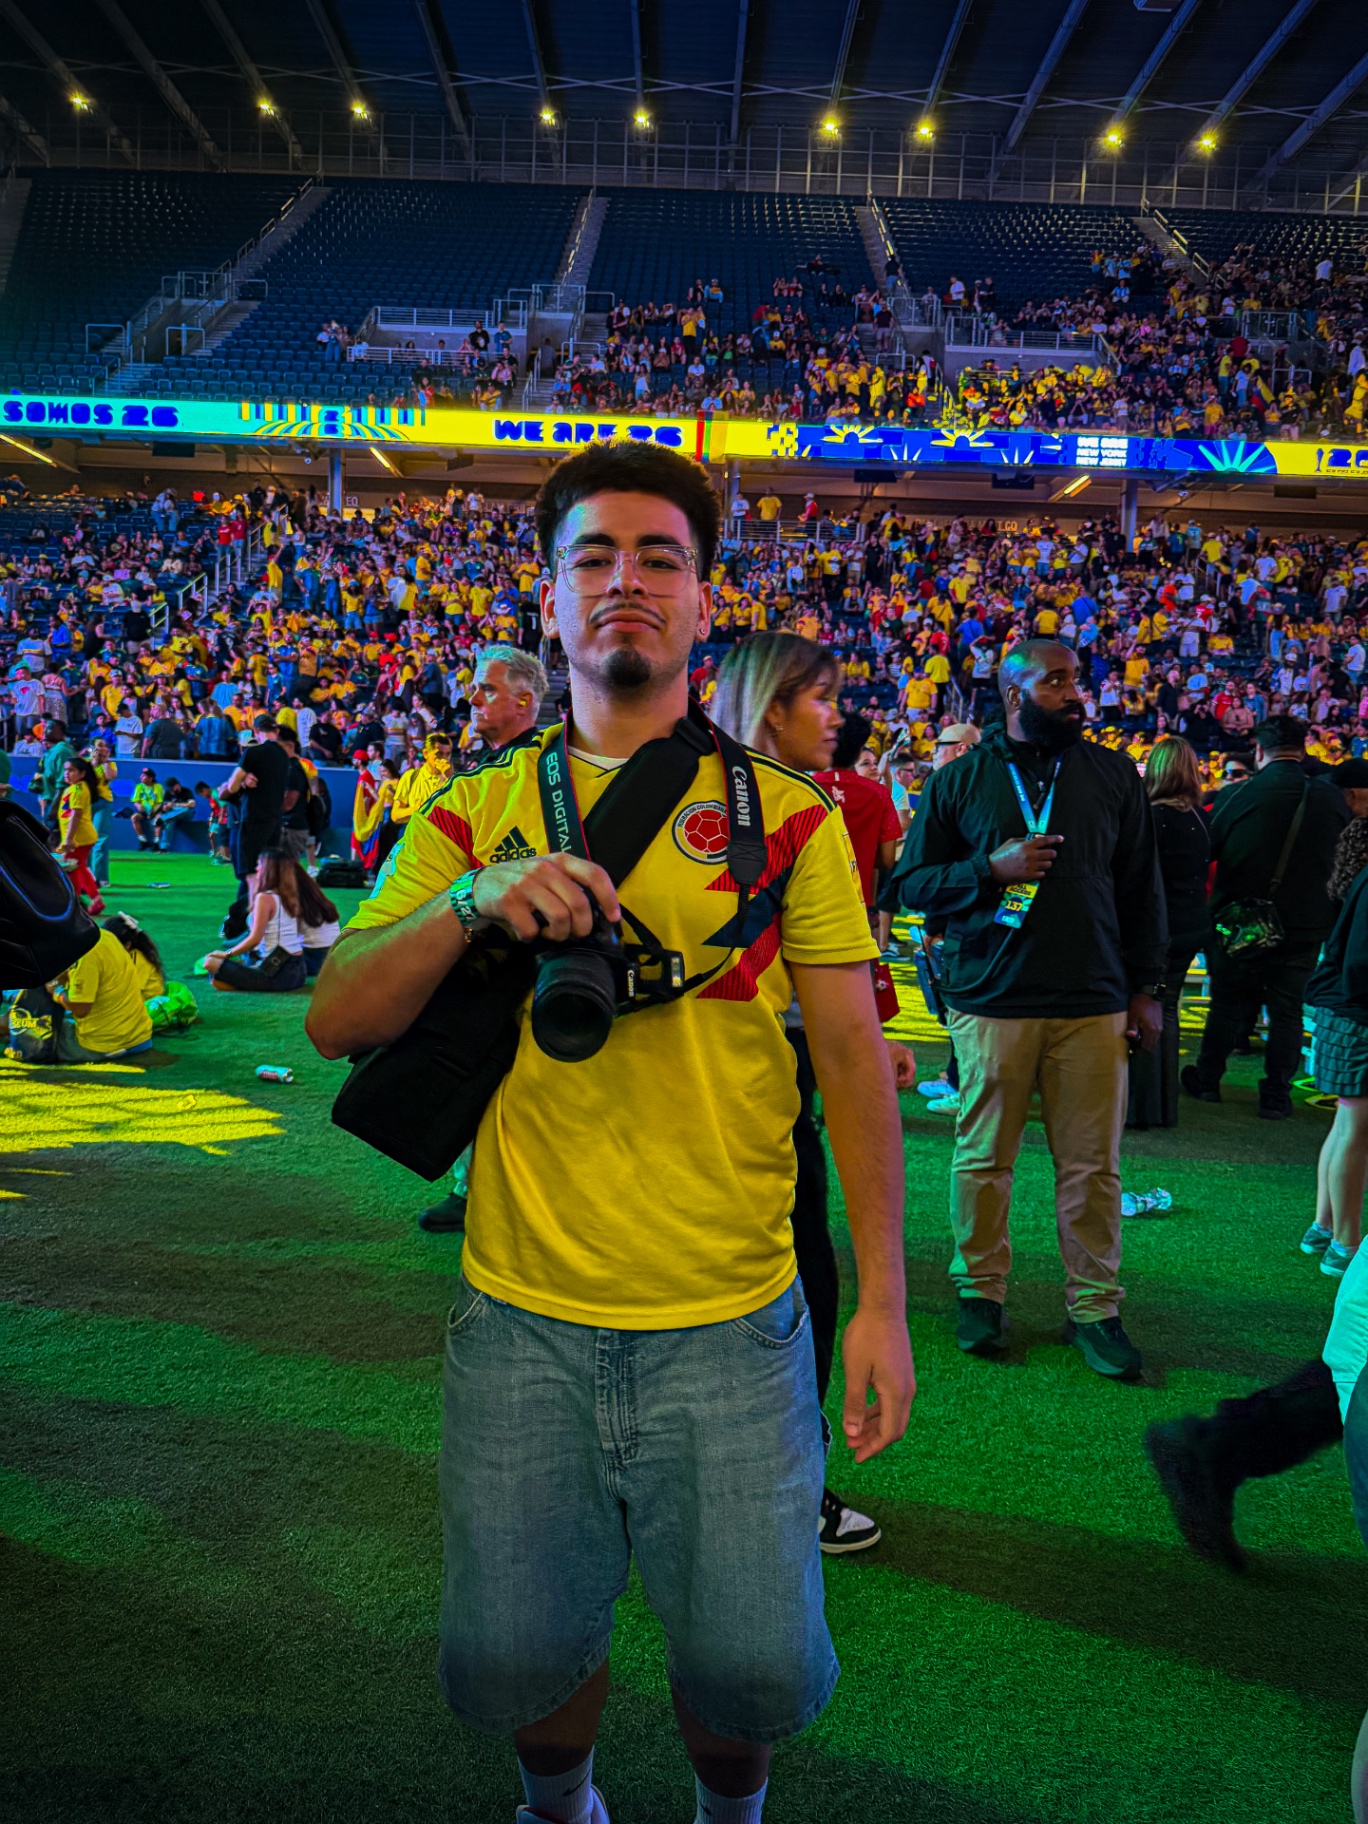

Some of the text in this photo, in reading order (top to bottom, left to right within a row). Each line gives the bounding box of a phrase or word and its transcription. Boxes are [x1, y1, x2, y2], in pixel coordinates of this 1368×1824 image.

[4, 401, 179, 427] SOMOS 26
[494, 419, 544, 442] WE
[552, 422, 617, 444] ARE
[1076, 456, 1098, 466] NEW
[1077, 448, 1127, 458] NEW YORK
[546, 752, 562, 786] EOS
[732, 765, 751, 827] Canon
[489, 847, 538, 864] adidas
[1005, 900, 1023, 912] 137
[627, 969, 635, 998] Canon
